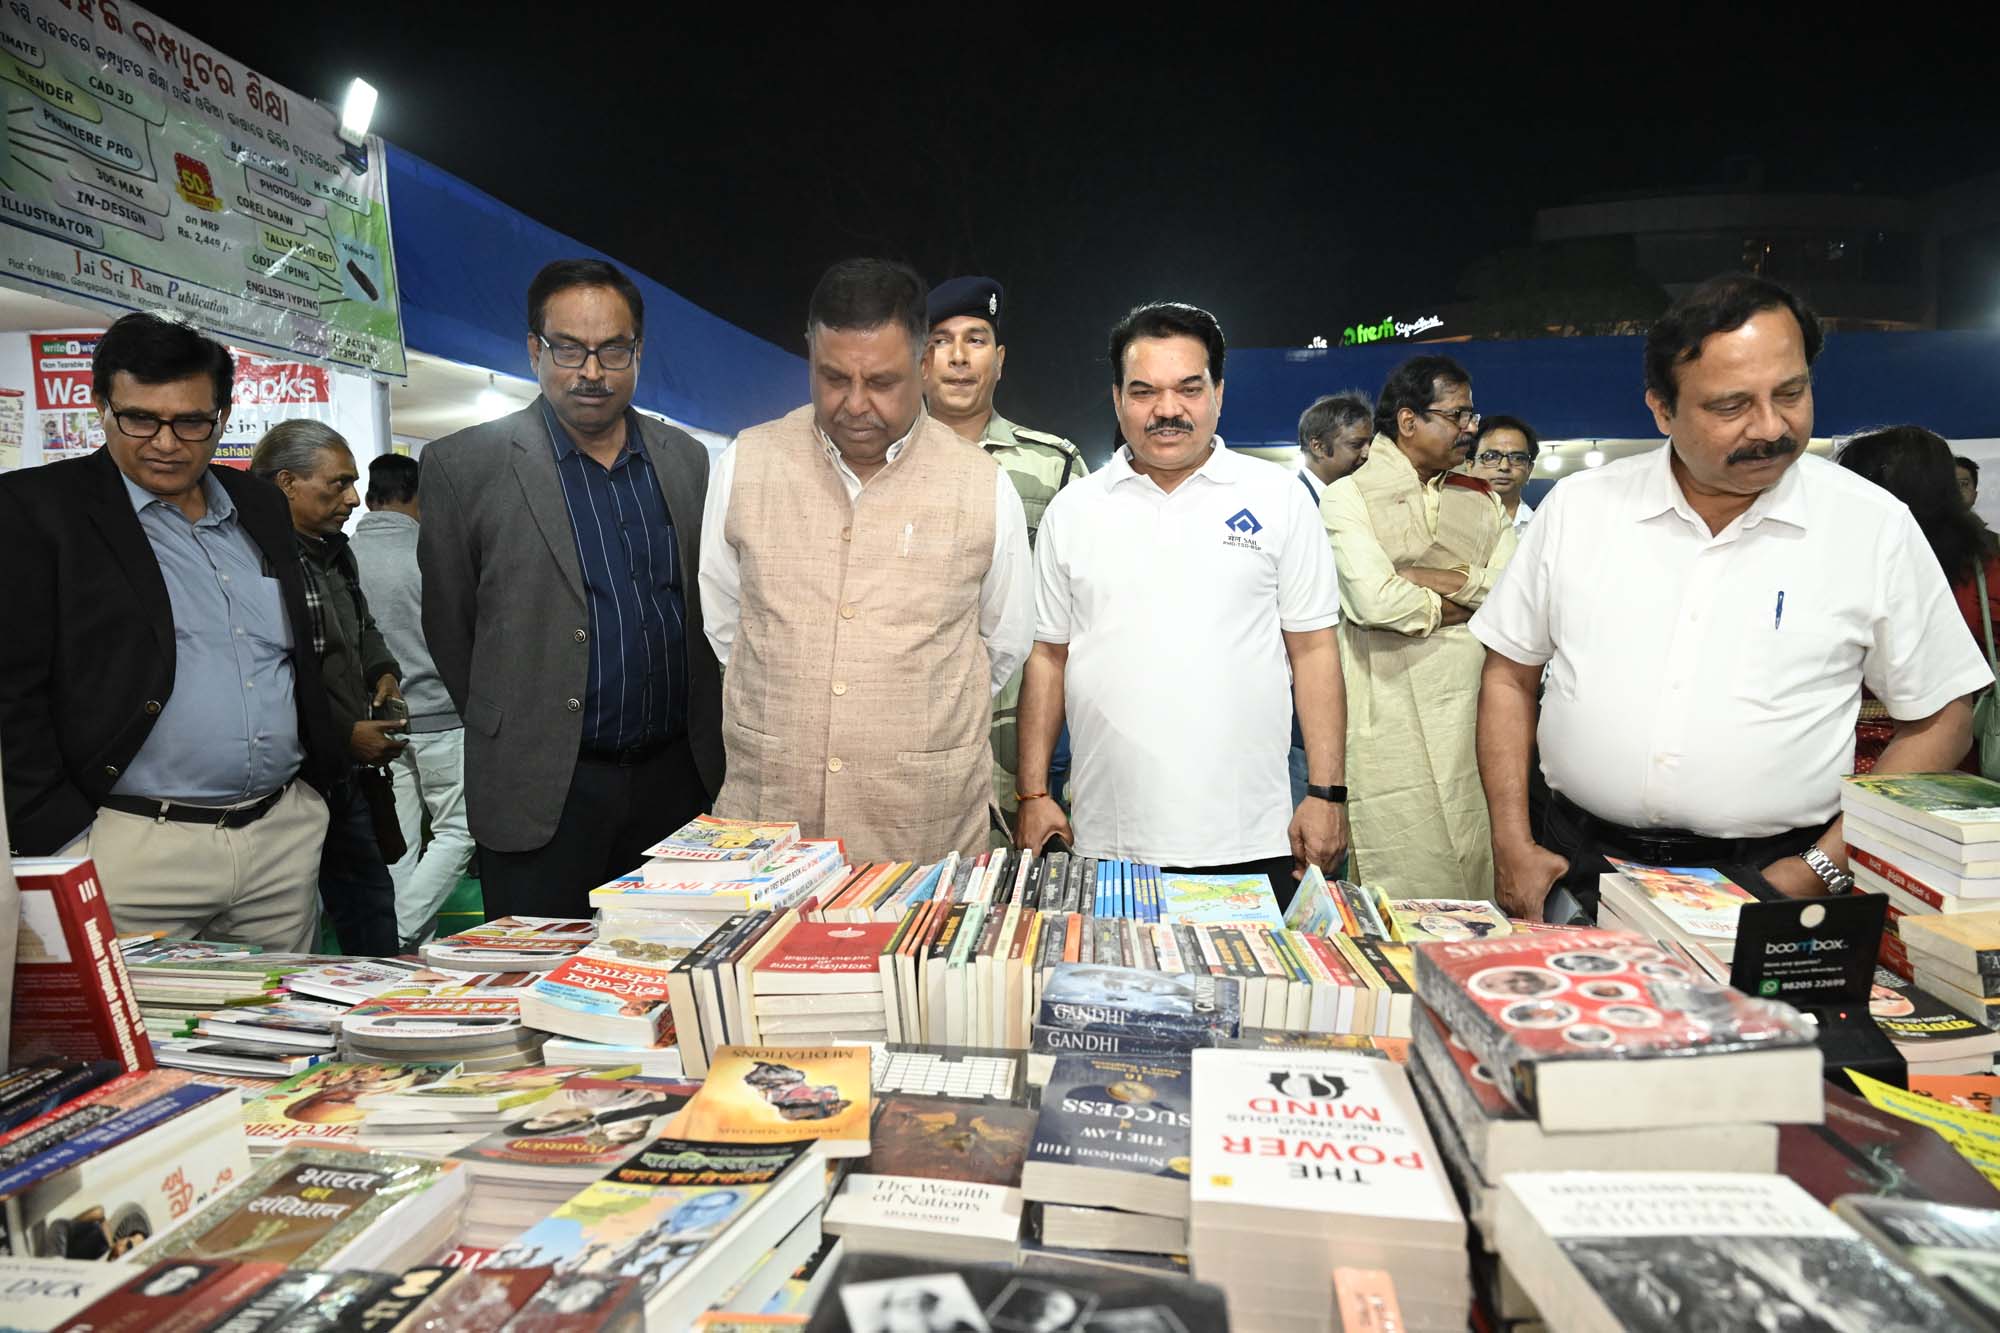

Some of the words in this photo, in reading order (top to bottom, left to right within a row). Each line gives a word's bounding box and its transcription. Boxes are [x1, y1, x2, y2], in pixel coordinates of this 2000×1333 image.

[88, 76, 115, 96] CAD
[117, 89, 134, 105] 3D
[106, 139, 134, 160] PRO
[118, 179, 145, 200] MAX
[259, 178, 313, 209] PHOTOSHOP
[331, 187, 360, 207] OFFICE
[0, 196, 95, 238] ILLUSTRATOR
[76, 191, 147, 226] IN-DESIGN
[236, 195, 266, 217] COREL
[267, 205, 294, 228] DRAW
[177, 226, 194, 240] Rs.
[185, 214, 199, 225] on
[200, 217, 221, 233] MRP
[263, 231, 292, 250] TALLY
[316, 250, 334, 266] GST
[73, 250, 96, 277] Jai
[100, 259, 125, 285] Sri
[130, 267, 164, 296] Ram
[167, 280, 230, 315] Publication
[245, 279, 286, 301] ENGLISH
[42, 343, 66, 354] write
[70, 343, 77, 353] n
[81, 342, 96, 355] wip
[671, 881, 704, 891] IN
[710, 881, 754, 891] ALL
[84, 917, 107, 958] Indian
[1765, 938, 1844, 955] boombox
[96, 958, 119, 1000] Temple
[407, 1000, 519, 1013] Letters
[1053, 1003, 1125, 1026] GANDHI
[106, 1001, 139, 1072] Architecture
[1047, 1031, 1120, 1053] GANDHI
[730, 1049, 855, 1061] MEDITATIONS
[1061, 1098, 1191, 1127] SUCCESS
[1247, 1097, 1382, 1123] MIND
[1079, 1126, 1122, 1141] LAW
[1225, 1114, 1406, 1136] SUBCONSCIOUS
[1036, 1141, 1071, 1157] Hill
[1127, 1131, 1166, 1147] THE
[1076, 1146, 1165, 1167] Napoleon
[1220, 1135, 1425, 1170] POWER
[296, 1167, 383, 1191] भारत
[1287, 1162, 1371, 1185] THE
[876, 1178, 917, 1195] The
[921, 1181, 993, 1201] Wealth
[247, 1194, 352, 1220] संविधान
[872, 1190, 896, 1204] of
[899, 1192, 982, 1213] Nations
